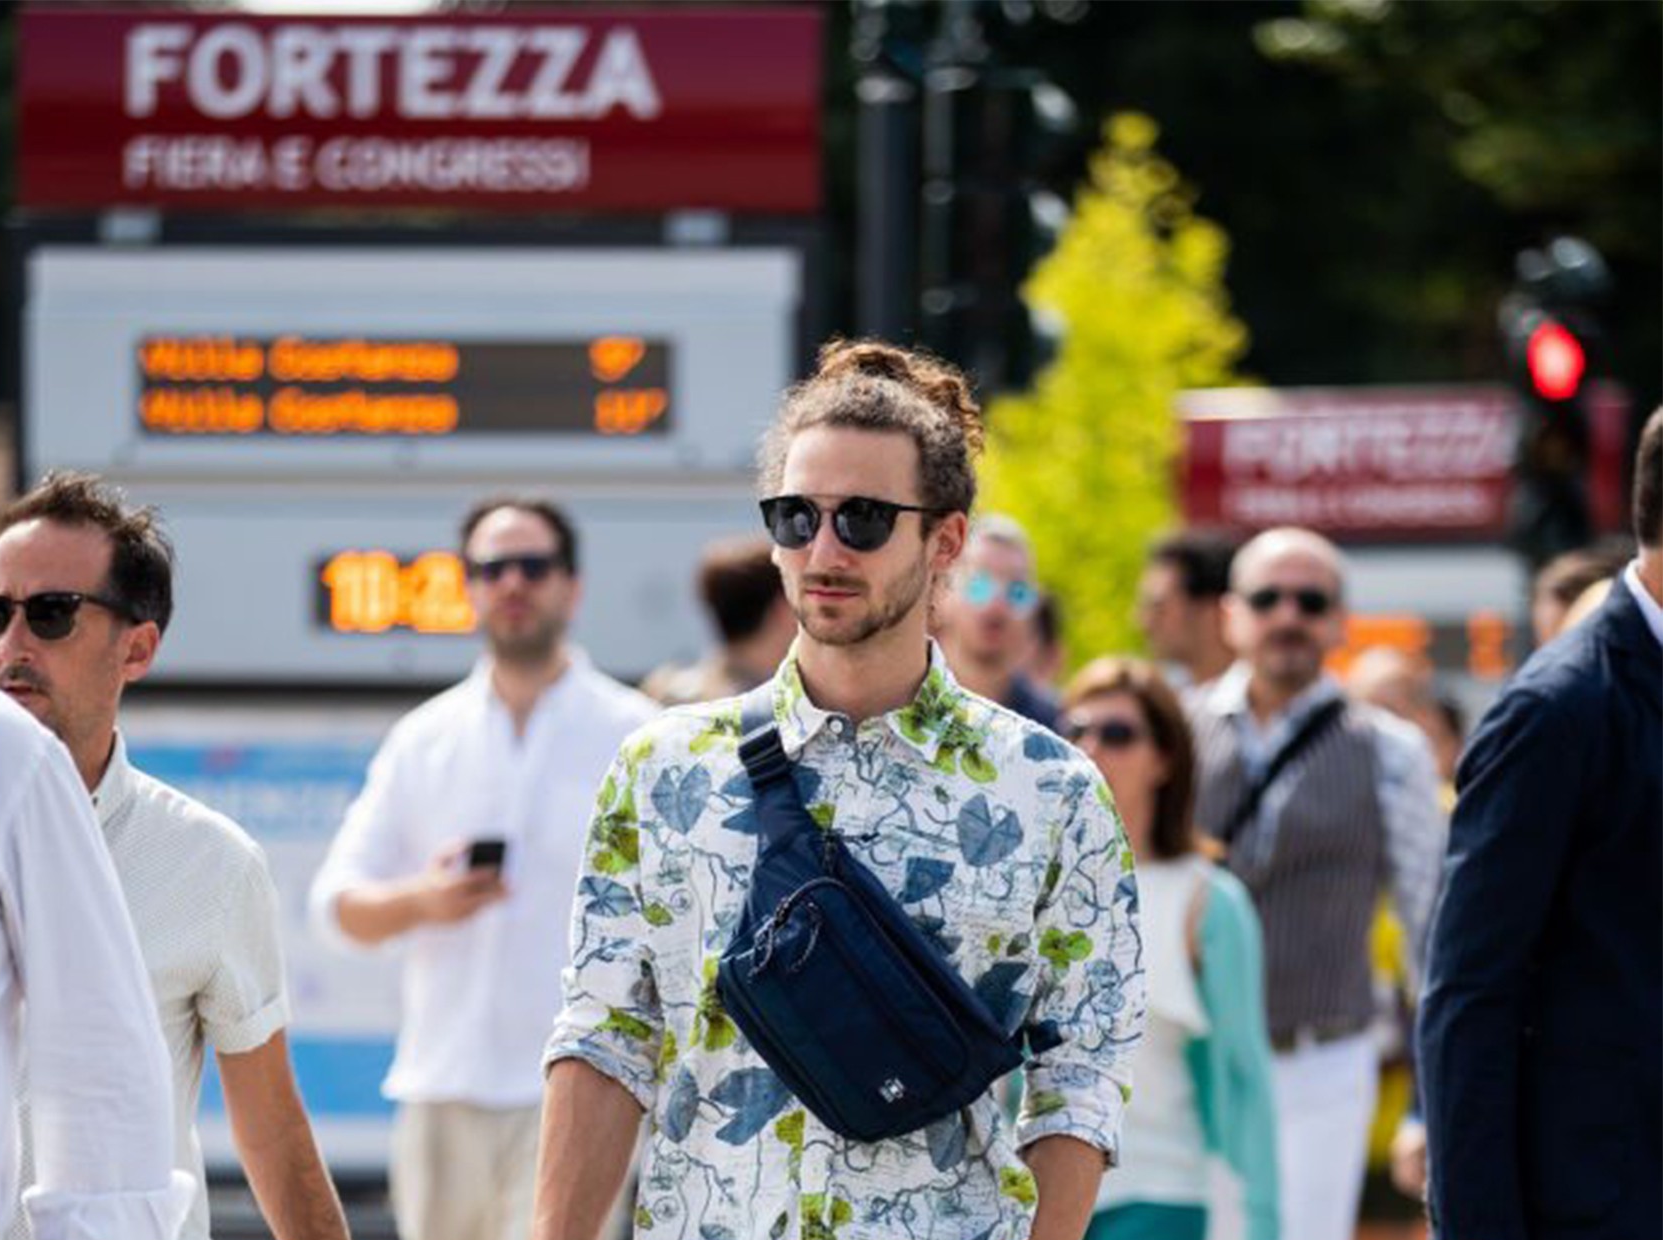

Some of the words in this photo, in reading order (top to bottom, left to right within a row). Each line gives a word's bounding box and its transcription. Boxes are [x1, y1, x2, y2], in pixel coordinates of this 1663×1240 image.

[125, 23, 660, 119] FORTEZZA
[124, 136, 266, 190] FIERA
[275, 136, 313, 190] E
[317, 136, 590, 191] CONGRESSI
